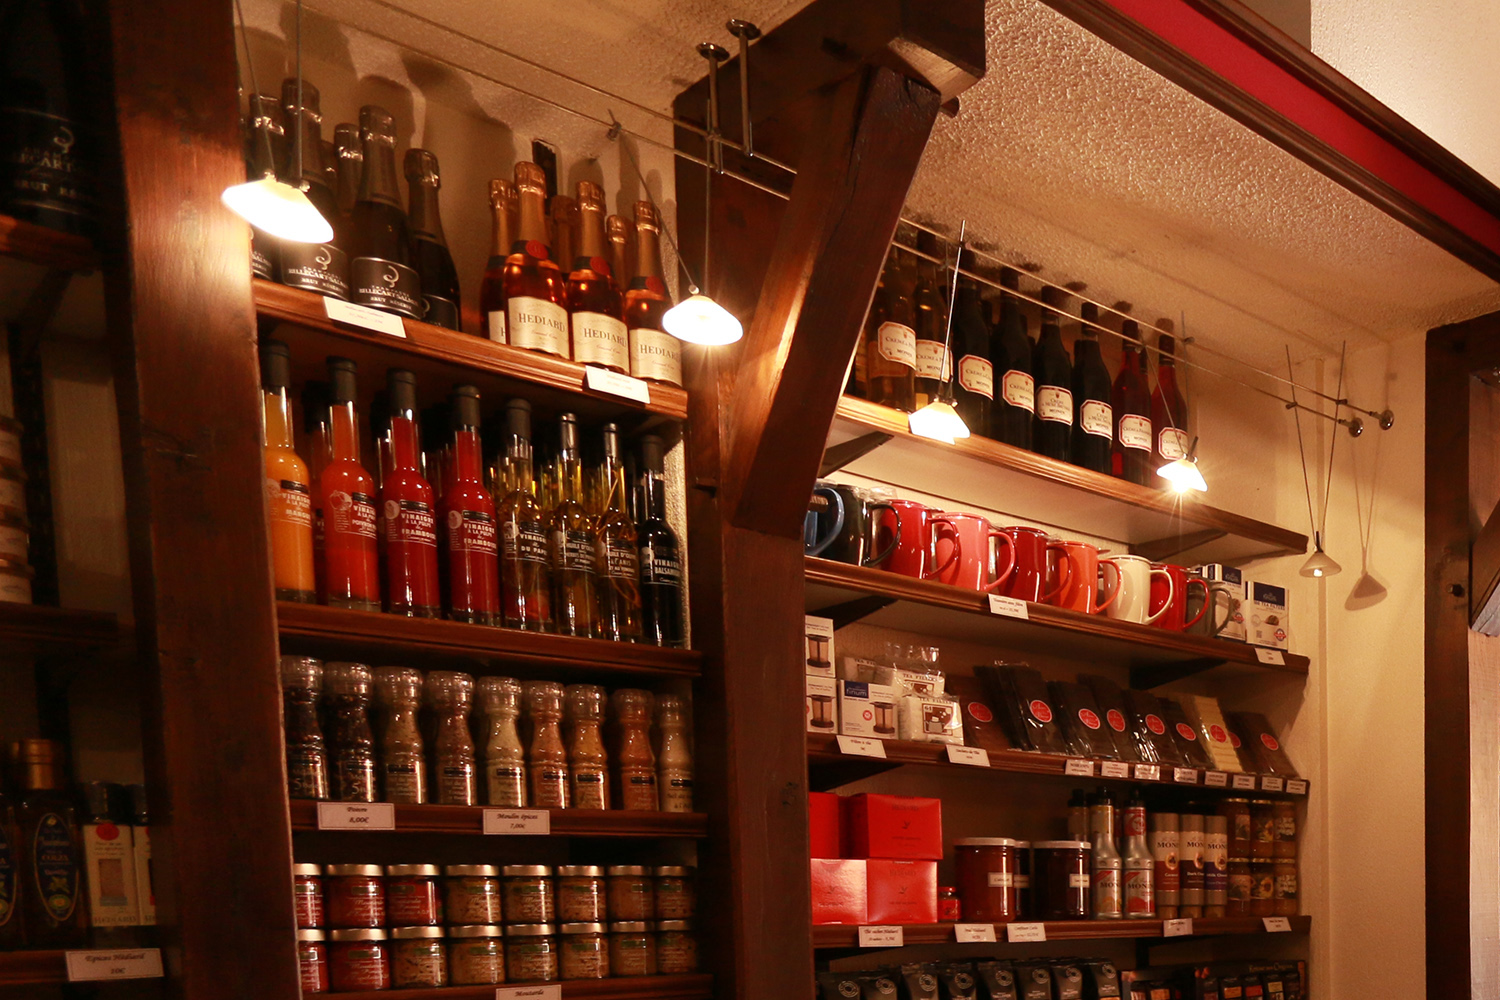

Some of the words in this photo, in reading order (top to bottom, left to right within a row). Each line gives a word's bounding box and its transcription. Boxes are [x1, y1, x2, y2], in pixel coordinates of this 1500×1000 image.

[517, 312, 566, 333] HEDIARD
[583, 327, 627, 347] HEDIARD
[401, 513, 434, 525] VINAIGRE
[464, 523, 496, 535] VINAIGRE
